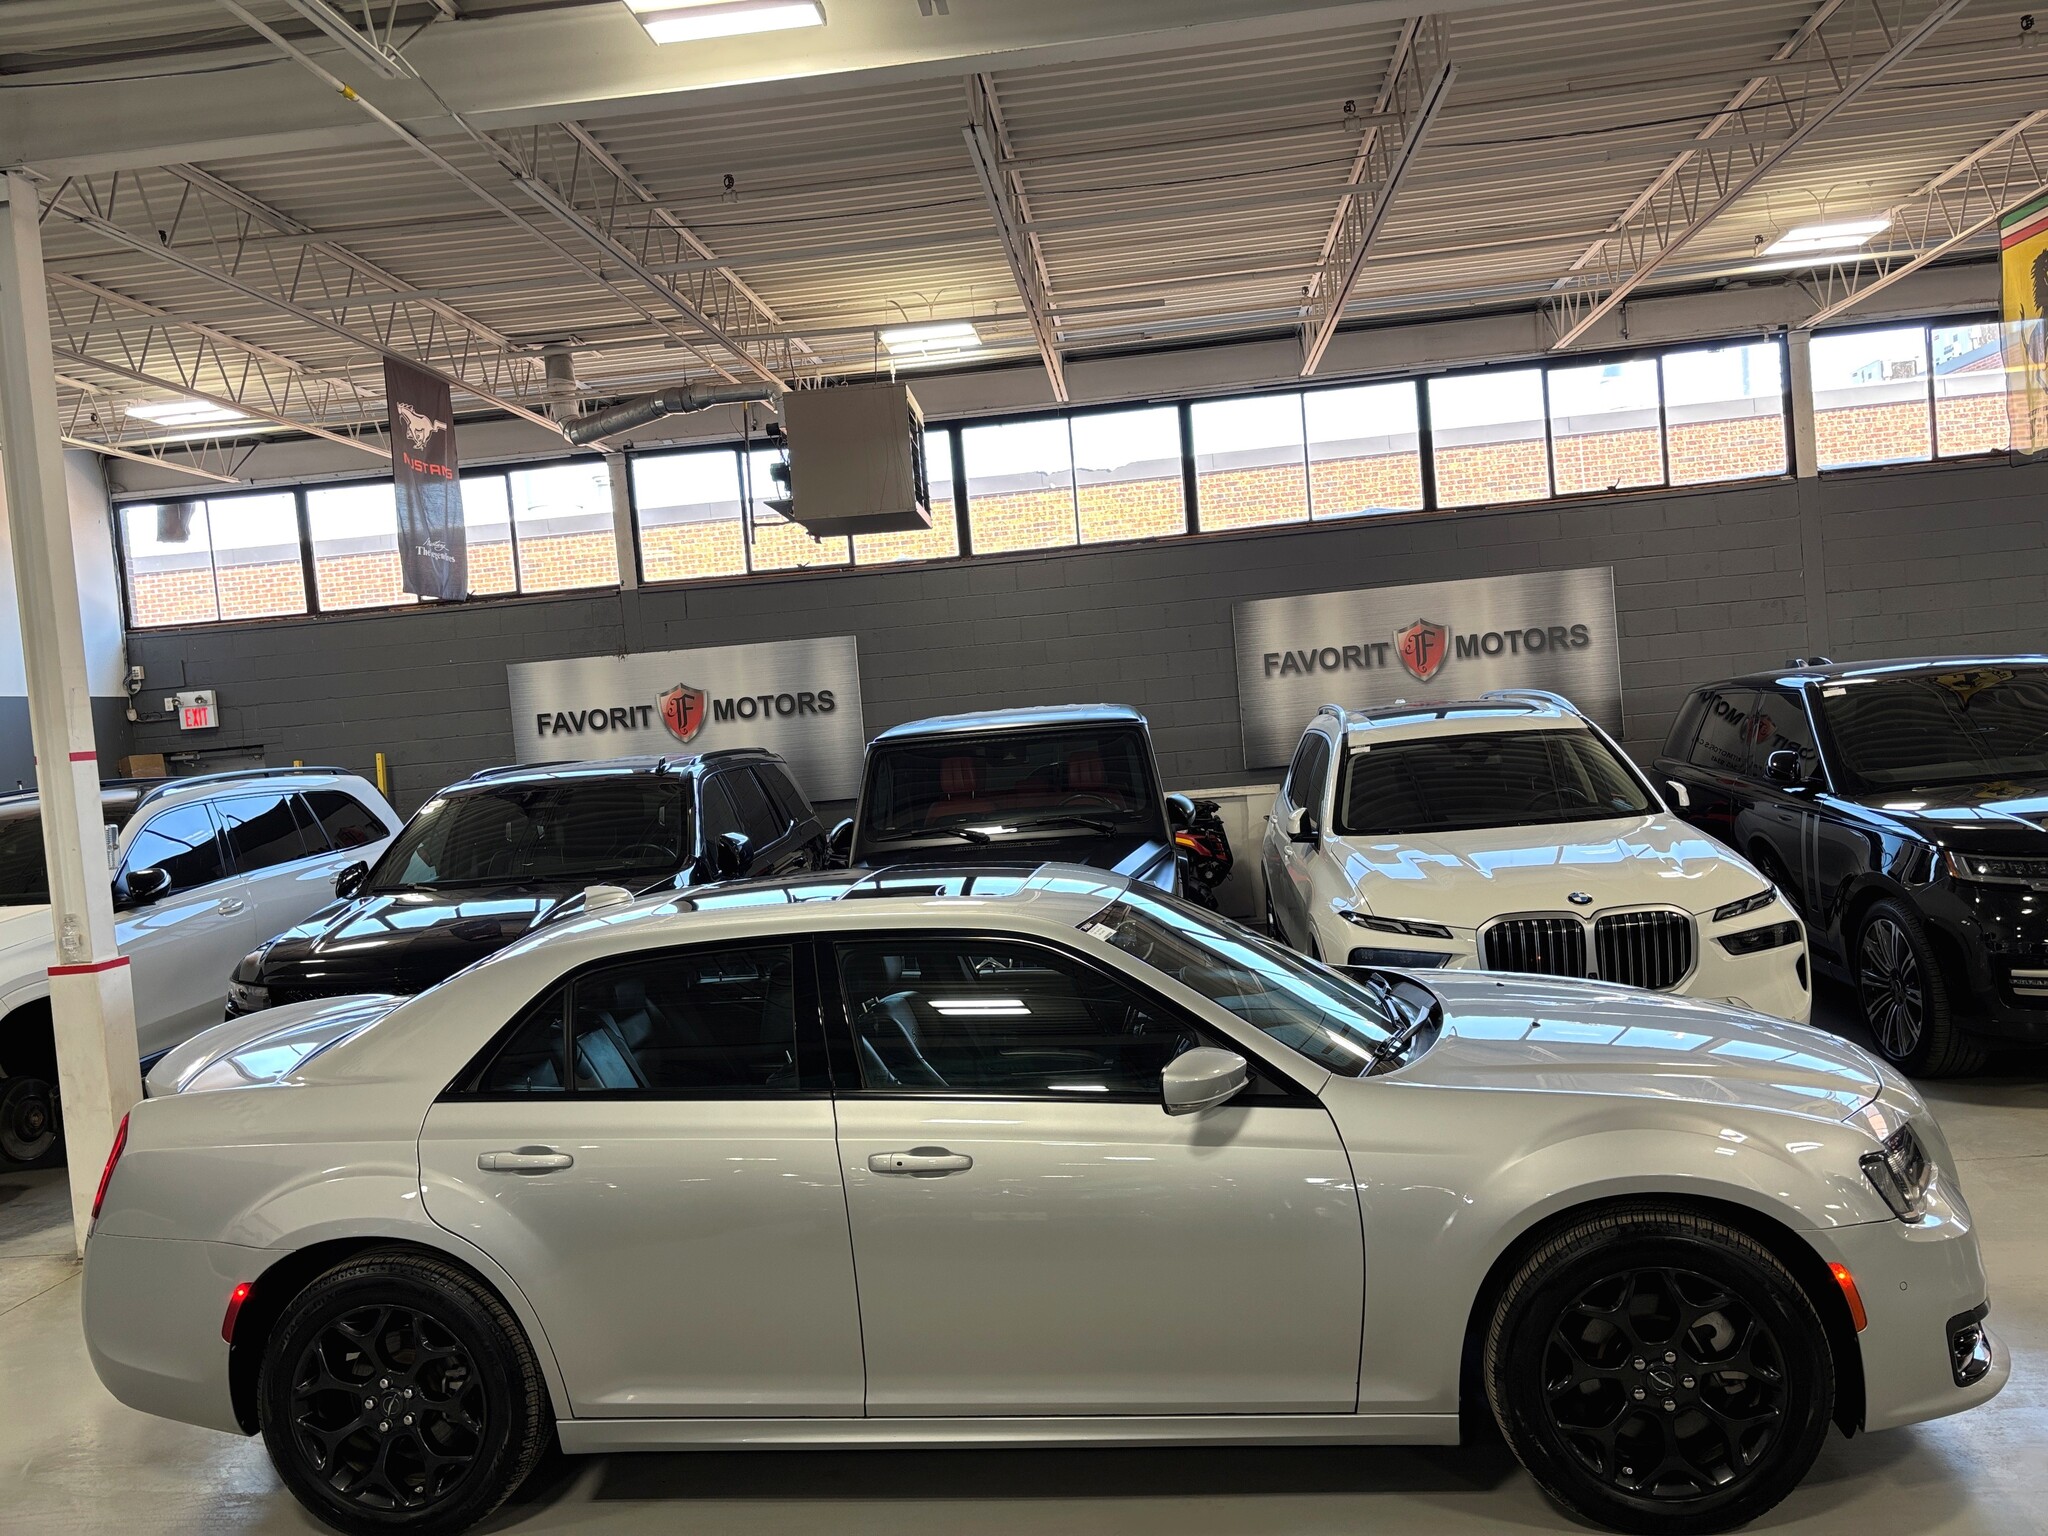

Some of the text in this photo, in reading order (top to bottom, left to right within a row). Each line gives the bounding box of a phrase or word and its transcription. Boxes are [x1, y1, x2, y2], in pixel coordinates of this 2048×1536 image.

[1263, 642, 1389, 676] FAVORIT
[1455, 623, 1590, 658] MOTORS
[184, 706, 208, 727] EXIT
[536, 705, 653, 735] FAVORIT
[713, 690, 836, 721] MOTORS
